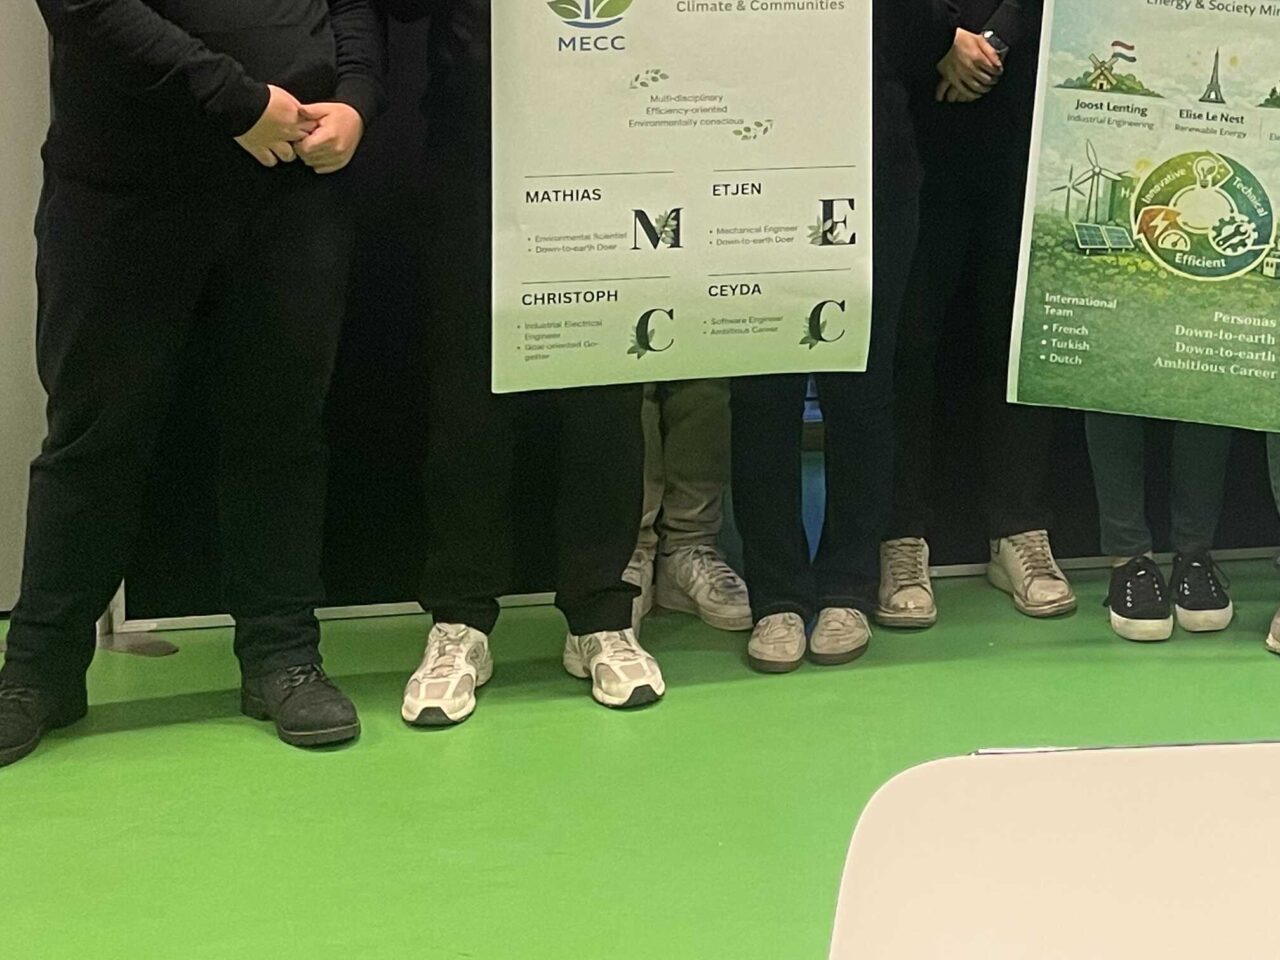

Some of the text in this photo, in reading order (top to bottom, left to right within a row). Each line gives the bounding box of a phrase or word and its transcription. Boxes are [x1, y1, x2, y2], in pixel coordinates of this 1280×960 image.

[676, 0, 733, 13] Climate
[736, 0, 746, 12] &
[1208, 0, 1257, 17] Society
[558, 35, 626, 52] MECC
[650, 94, 724, 104] Multi-disciplinary
[646, 105, 728, 116] Efficiency-oriented
[1075, 99, 1149, 118] Joost Lenting
[1179, 109, 1245, 125] Elise Le Nest
[629, 117, 745, 129] Environmentally conscious
[1067, 114, 1155, 131] Industrial Engineering
[1175, 123, 1247, 140] Renewable Energy
[712, 182, 762, 197] ETJEN
[1141, 167, 1187, 204] Innovative
[526, 188, 602, 204] MATHIAS
[1232, 176, 1269, 218] Technical
[630, 207, 684, 251] M
[716, 225, 762, 235] Mechanical
[716, 236, 774, 246] Down-to-earth
[1175, 252, 1227, 268] Efficient
[521, 289, 619, 306] CHRISTOPH
[708, 283, 762, 297] CEYDA
[1045, 292, 1117, 309] International
[1044, 305, 1074, 317] Team
[1213, 311, 1278, 328] Personas
[808, 299, 846, 343] C
[1052, 323, 1089, 336] French
[635, 308, 675, 352] C
[1175, 324, 1276, 346] Down-to-earth
[1051, 338, 1090, 352] Turkish
[1175, 341, 1276, 363] Down-to-earth
[1049, 353, 1083, 365] Dutch
[1153, 356, 1226, 375] Ambitious
[1230, 364, 1278, 380] Career
